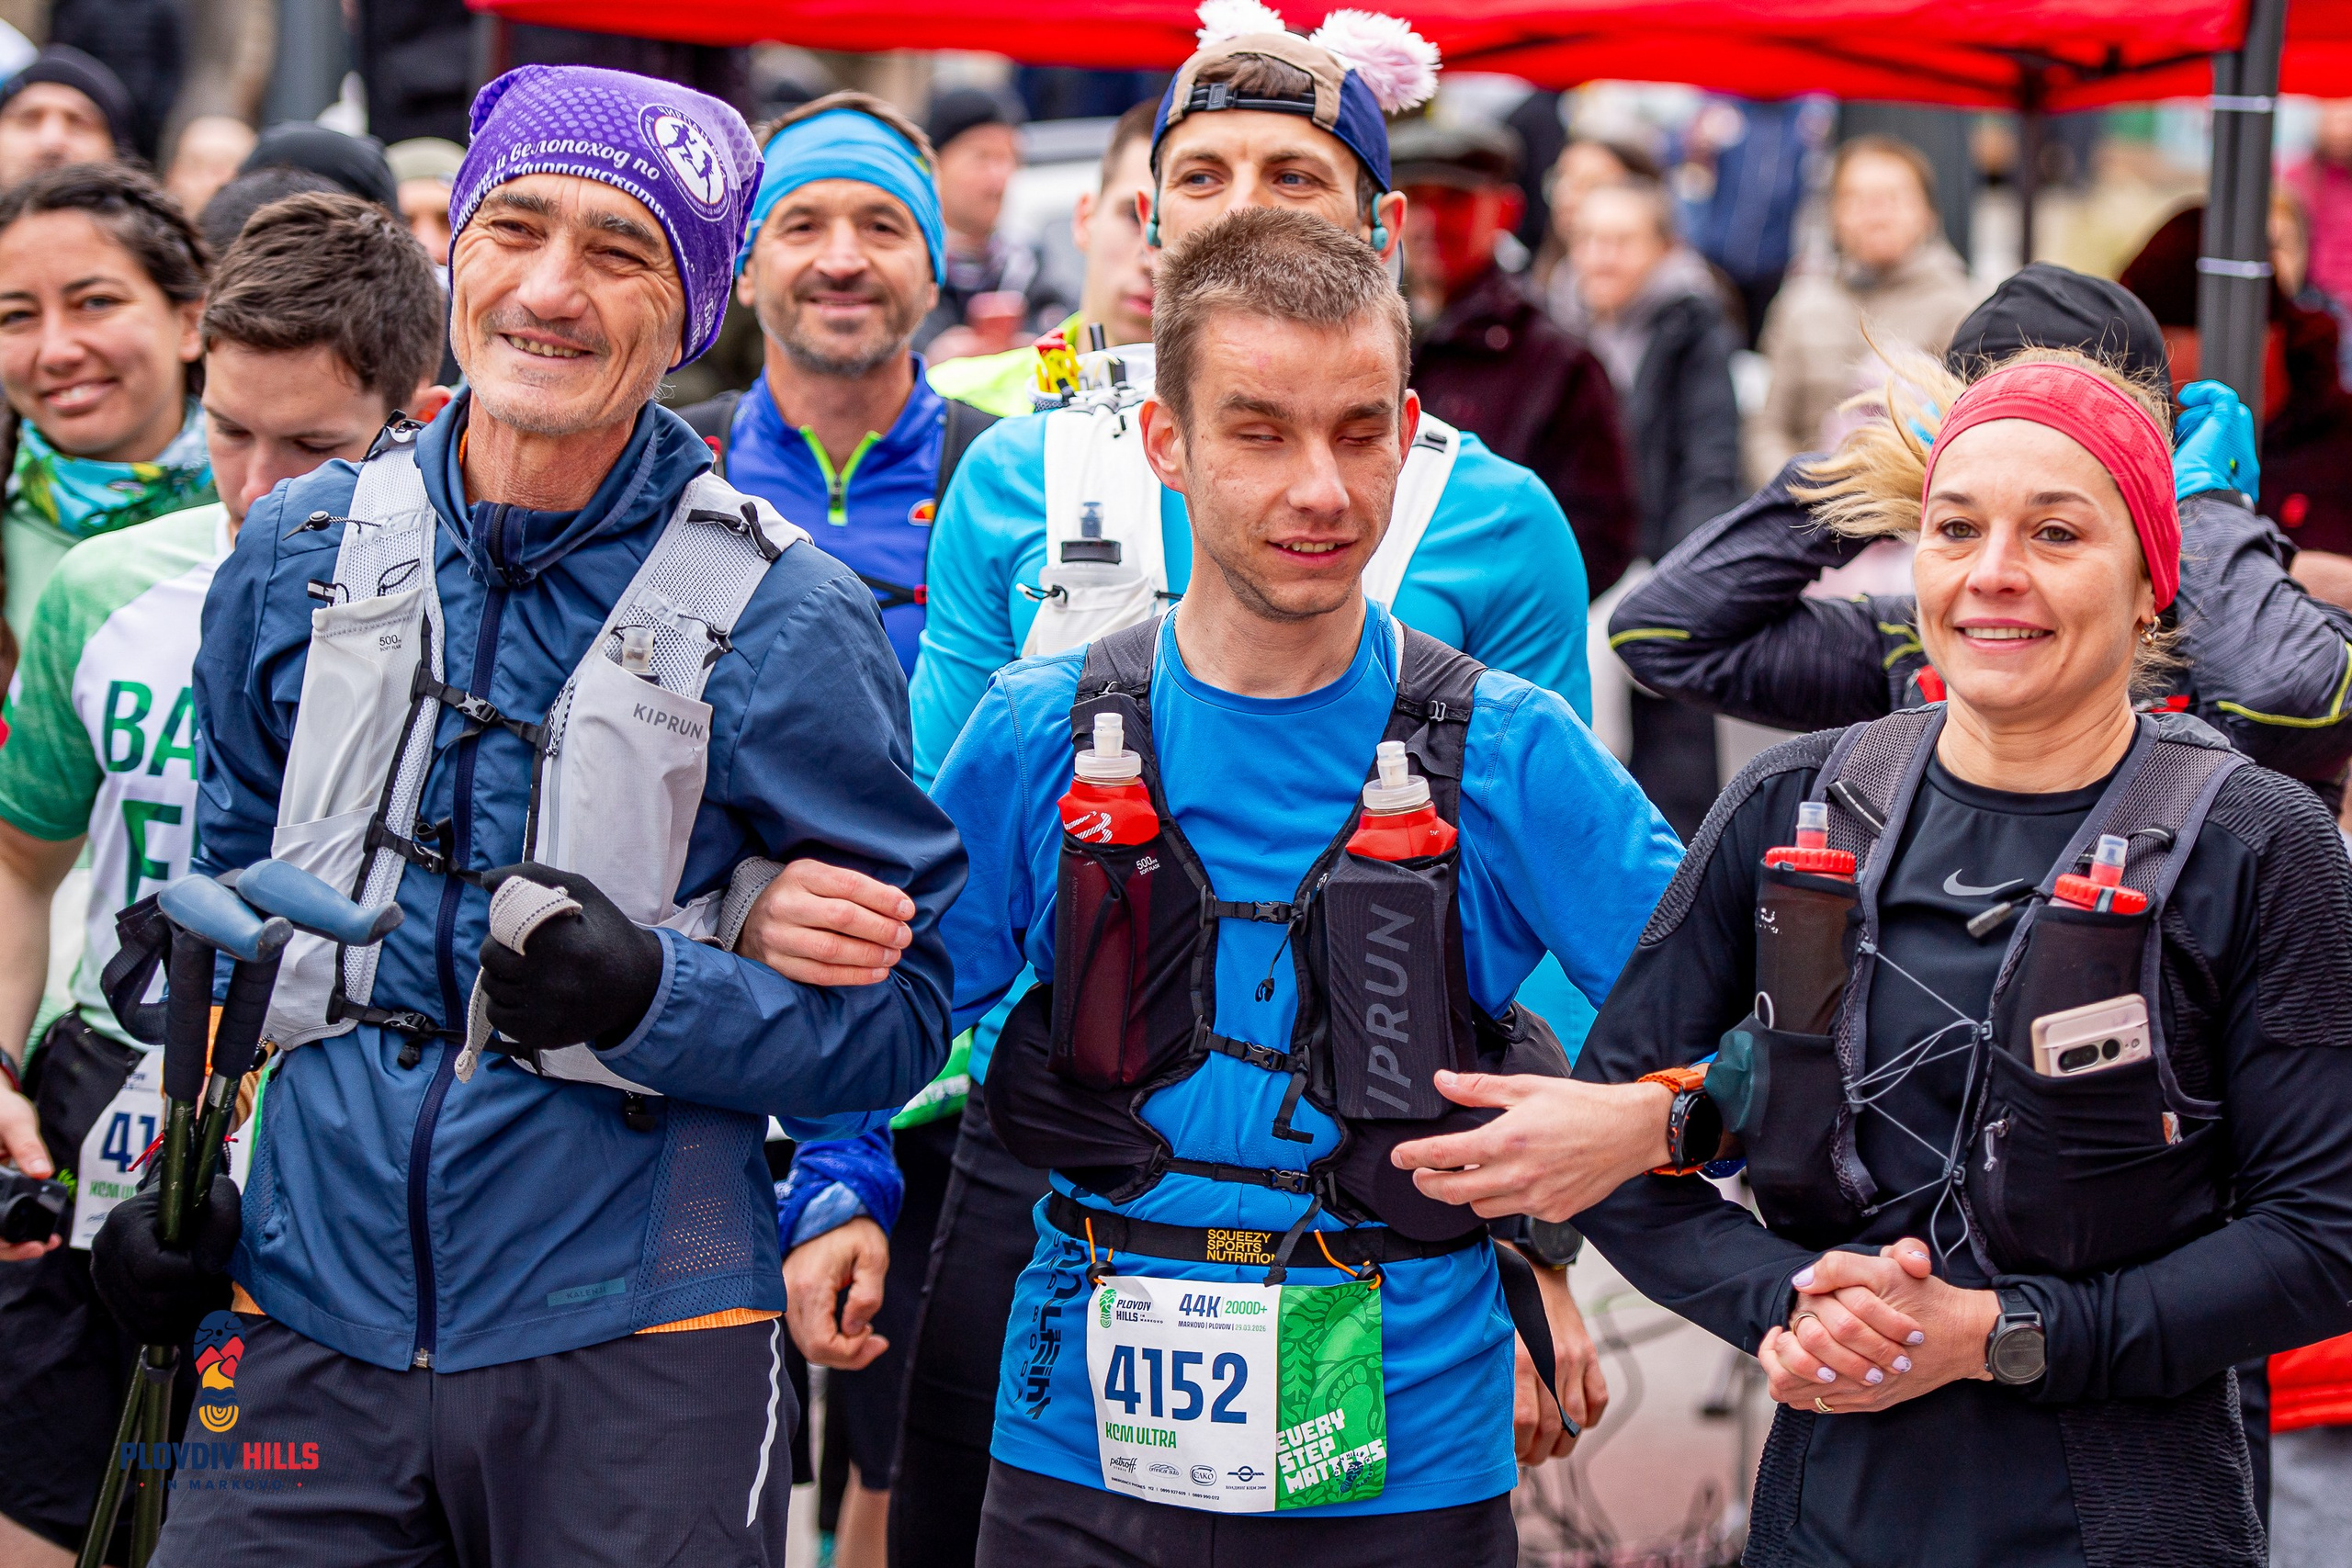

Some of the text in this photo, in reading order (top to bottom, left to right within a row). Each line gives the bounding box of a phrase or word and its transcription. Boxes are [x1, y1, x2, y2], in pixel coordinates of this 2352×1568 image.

[510, 138, 630, 169] велопоход
[633, 157, 660, 180] по
[632, 702, 704, 740] KIPRUN
[1363, 903, 1415, 1119] IPRUN
[1206, 1240, 1262, 1253] SPORTS
[1207, 1228, 1272, 1244] SQUEEZY
[1116, 1299, 1152, 1312] PLOVDIV
[1116, 1310, 1138, 1322] HILLS
[1179, 1293, 1268, 1318] 44K 2000D+
[1177, 1320, 1205, 1329] MARKOVO
[1208, 1323, 1231, 1331] PLOVDIV
[1104, 1344, 1250, 1425] 4152
[1105, 1421, 1177, 1449] KCM ULTRA
[1275, 1408, 1345, 1453] EVERY
[1277, 1436, 1336, 1474] STEP
[1283, 1438, 1387, 1495] MATTERS
